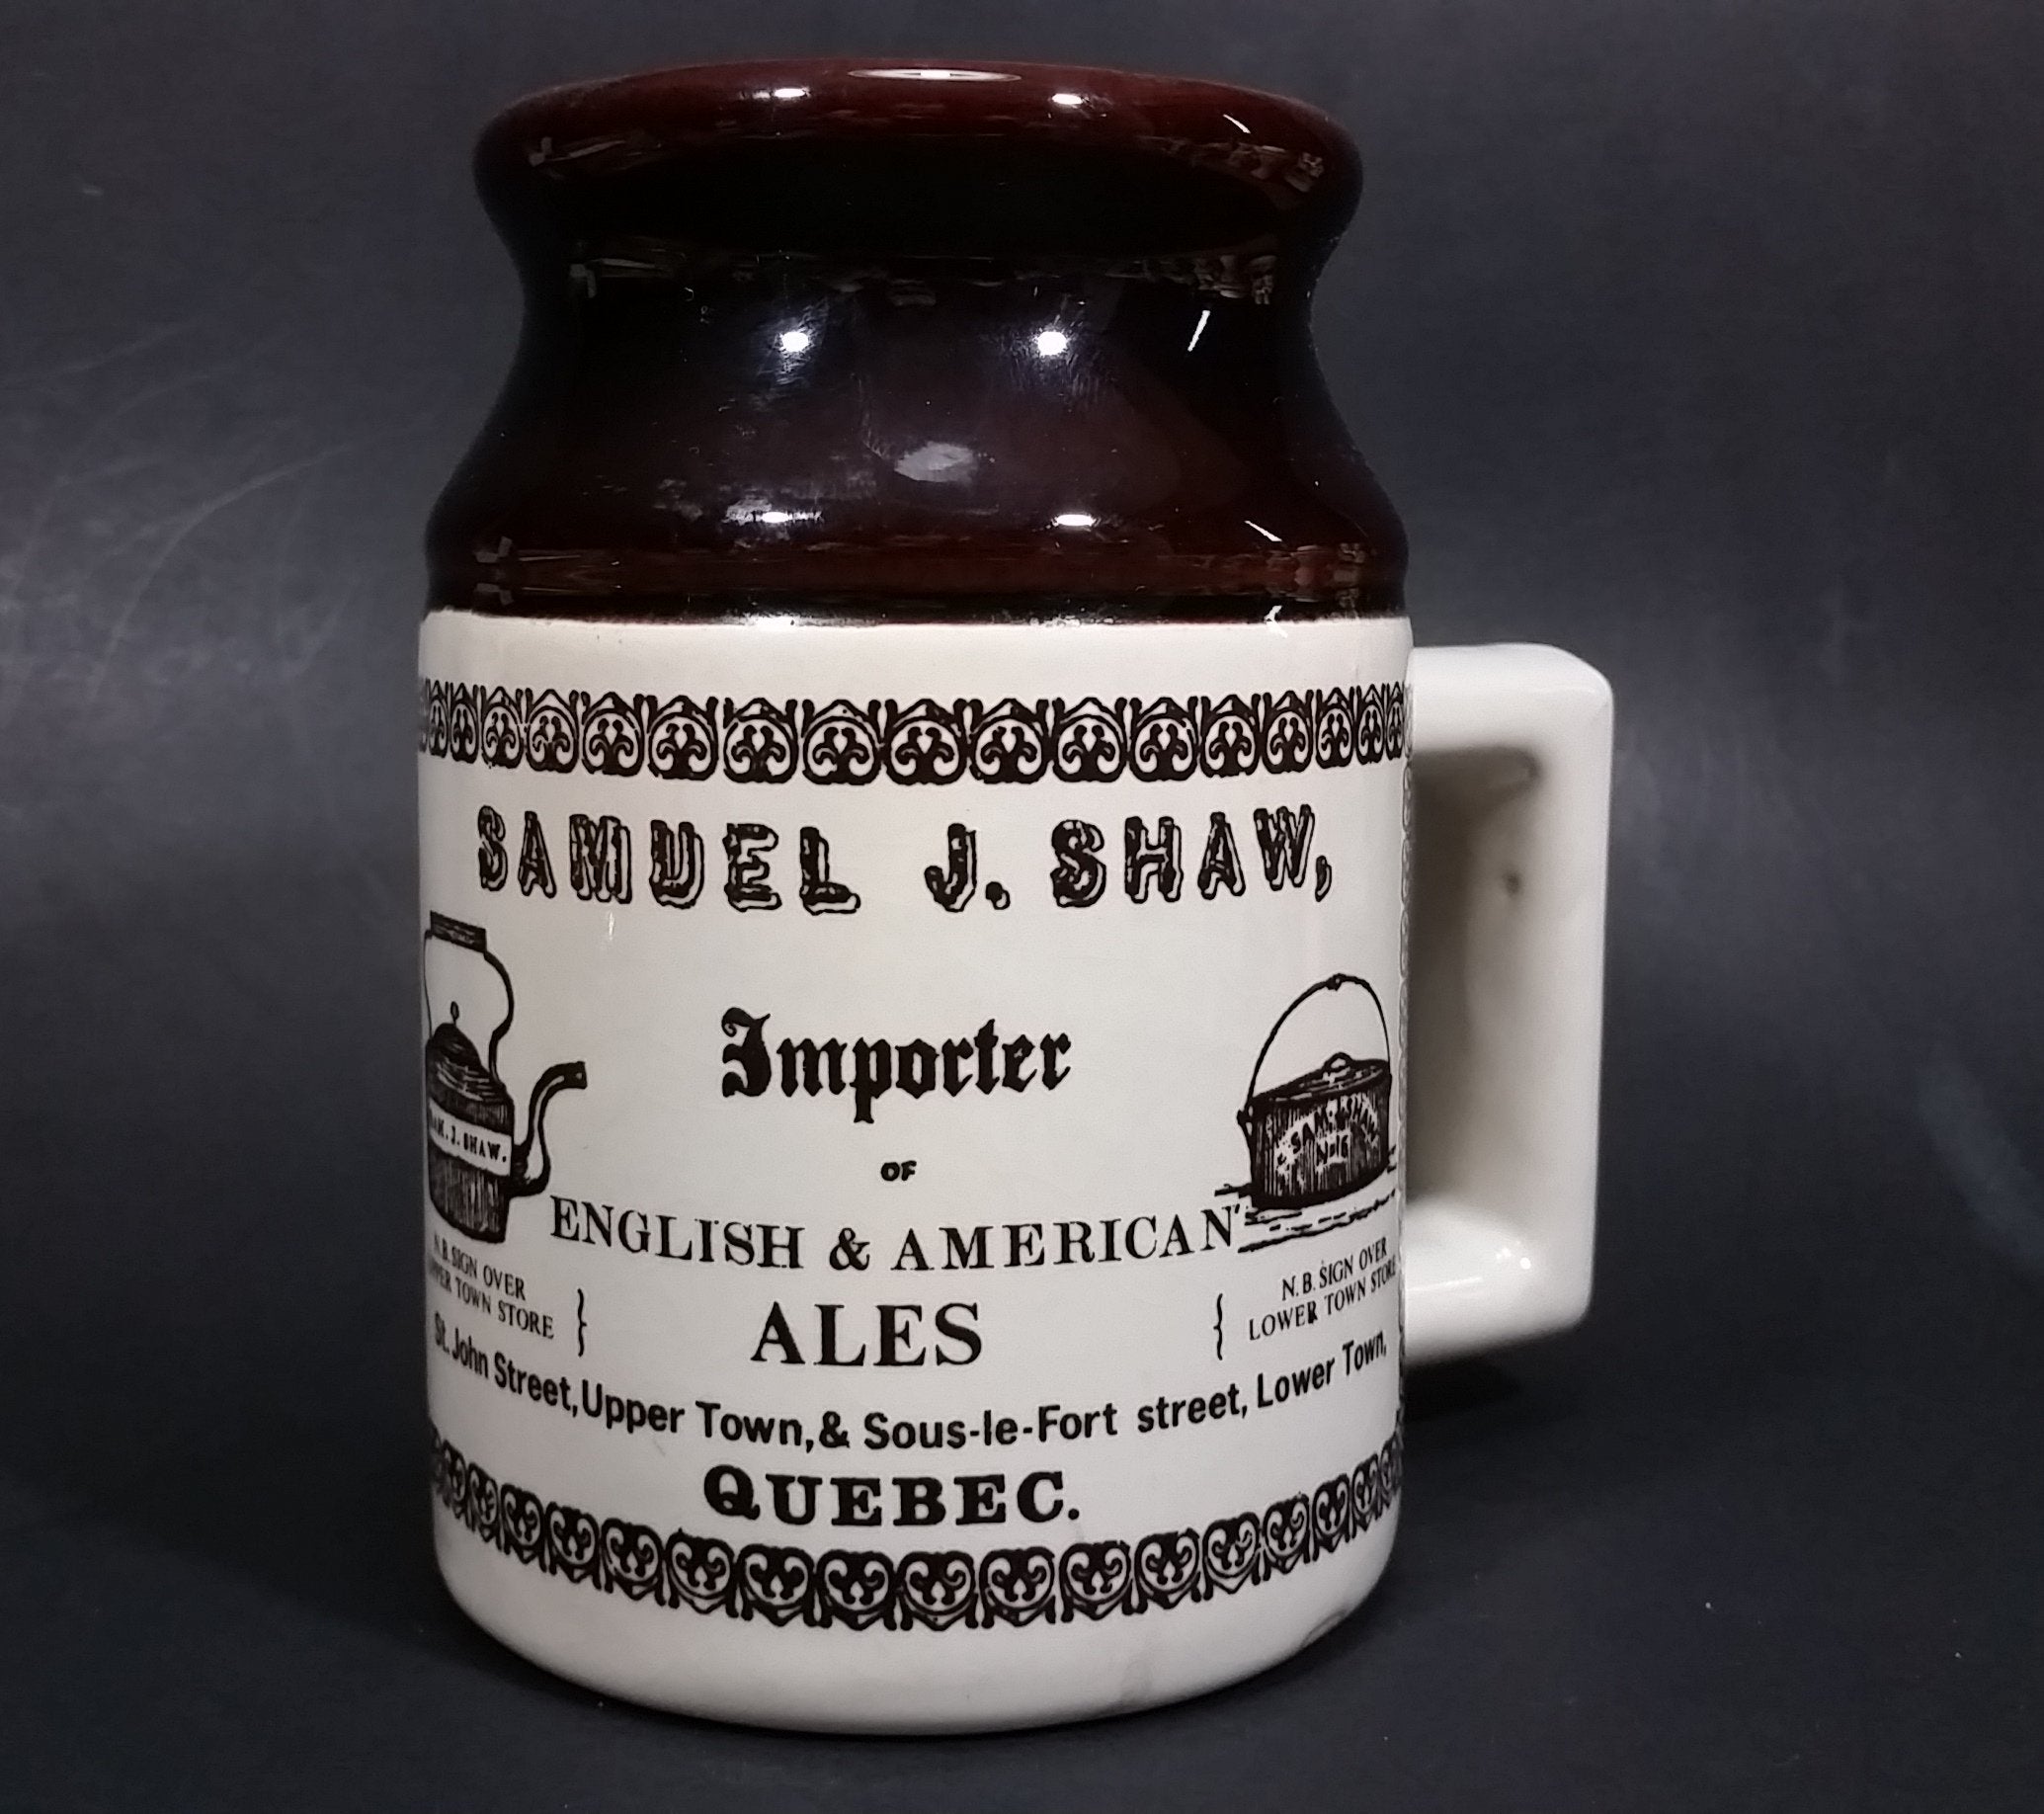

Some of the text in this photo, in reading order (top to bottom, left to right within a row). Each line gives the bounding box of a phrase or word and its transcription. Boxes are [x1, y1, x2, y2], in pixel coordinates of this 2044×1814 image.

[478, 804, 1333, 916] SAMUEL J. SHAW,
[721, 1007, 1072, 1124] Importer
[550, 1195, 1232, 1272] ENGLISH & AMERICAN
[1319, 1254, 1353, 1289] SIGN
[1358, 1236, 1387, 1271] OVER
[451, 1245, 478, 1279] SIGN
[483, 1264, 527, 1301] OVER
[454, 1276, 491, 1314] TOWN
[498, 1299, 554, 1340] STORE
[1249, 1254, 1397, 1341] LOWER TOWN STORE
[751, 1301, 983, 1367] ALES
[451, 1327, 489, 1379] John
[1137, 1382, 1248, 1433] street,
[1257, 1357, 1336, 1408] Lower
[703, 1464, 1081, 1527] QUEBEC.
